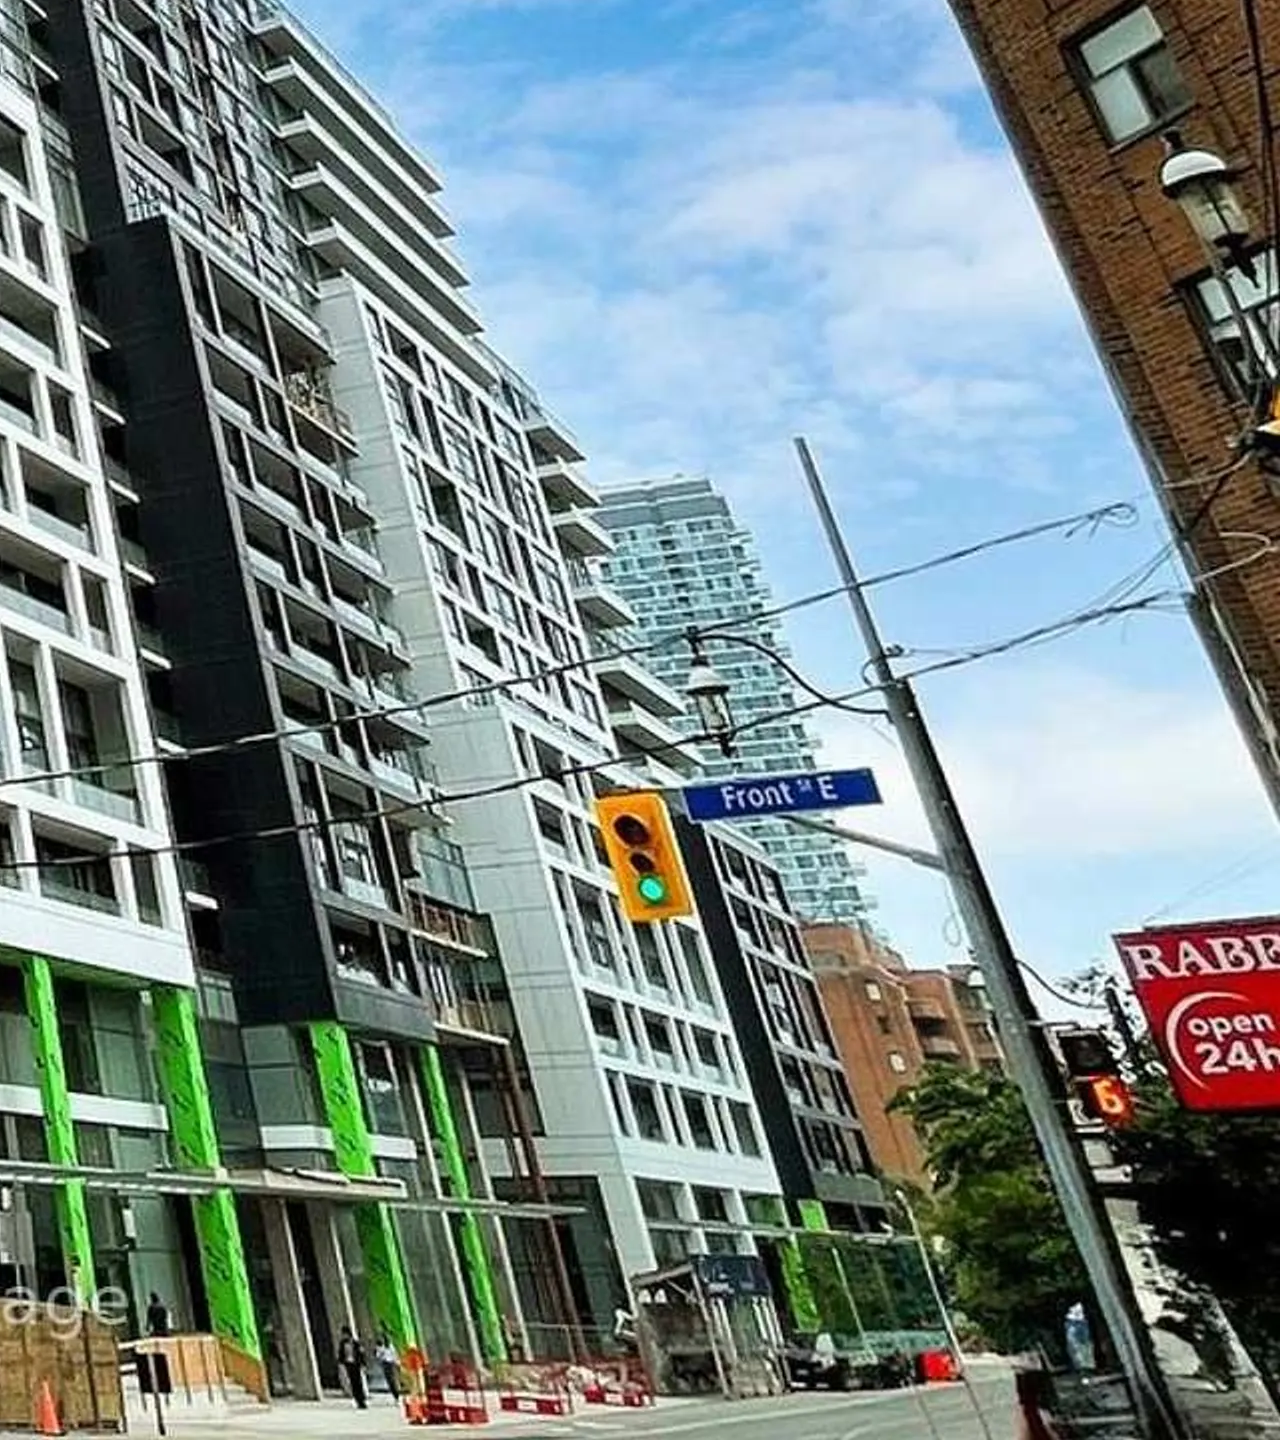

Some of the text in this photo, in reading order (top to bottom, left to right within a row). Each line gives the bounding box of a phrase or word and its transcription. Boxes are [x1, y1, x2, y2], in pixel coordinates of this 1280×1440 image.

[719, 781, 794, 811] Front
[816, 774, 839, 801] E
[1187, 1012, 1277, 1043] open
